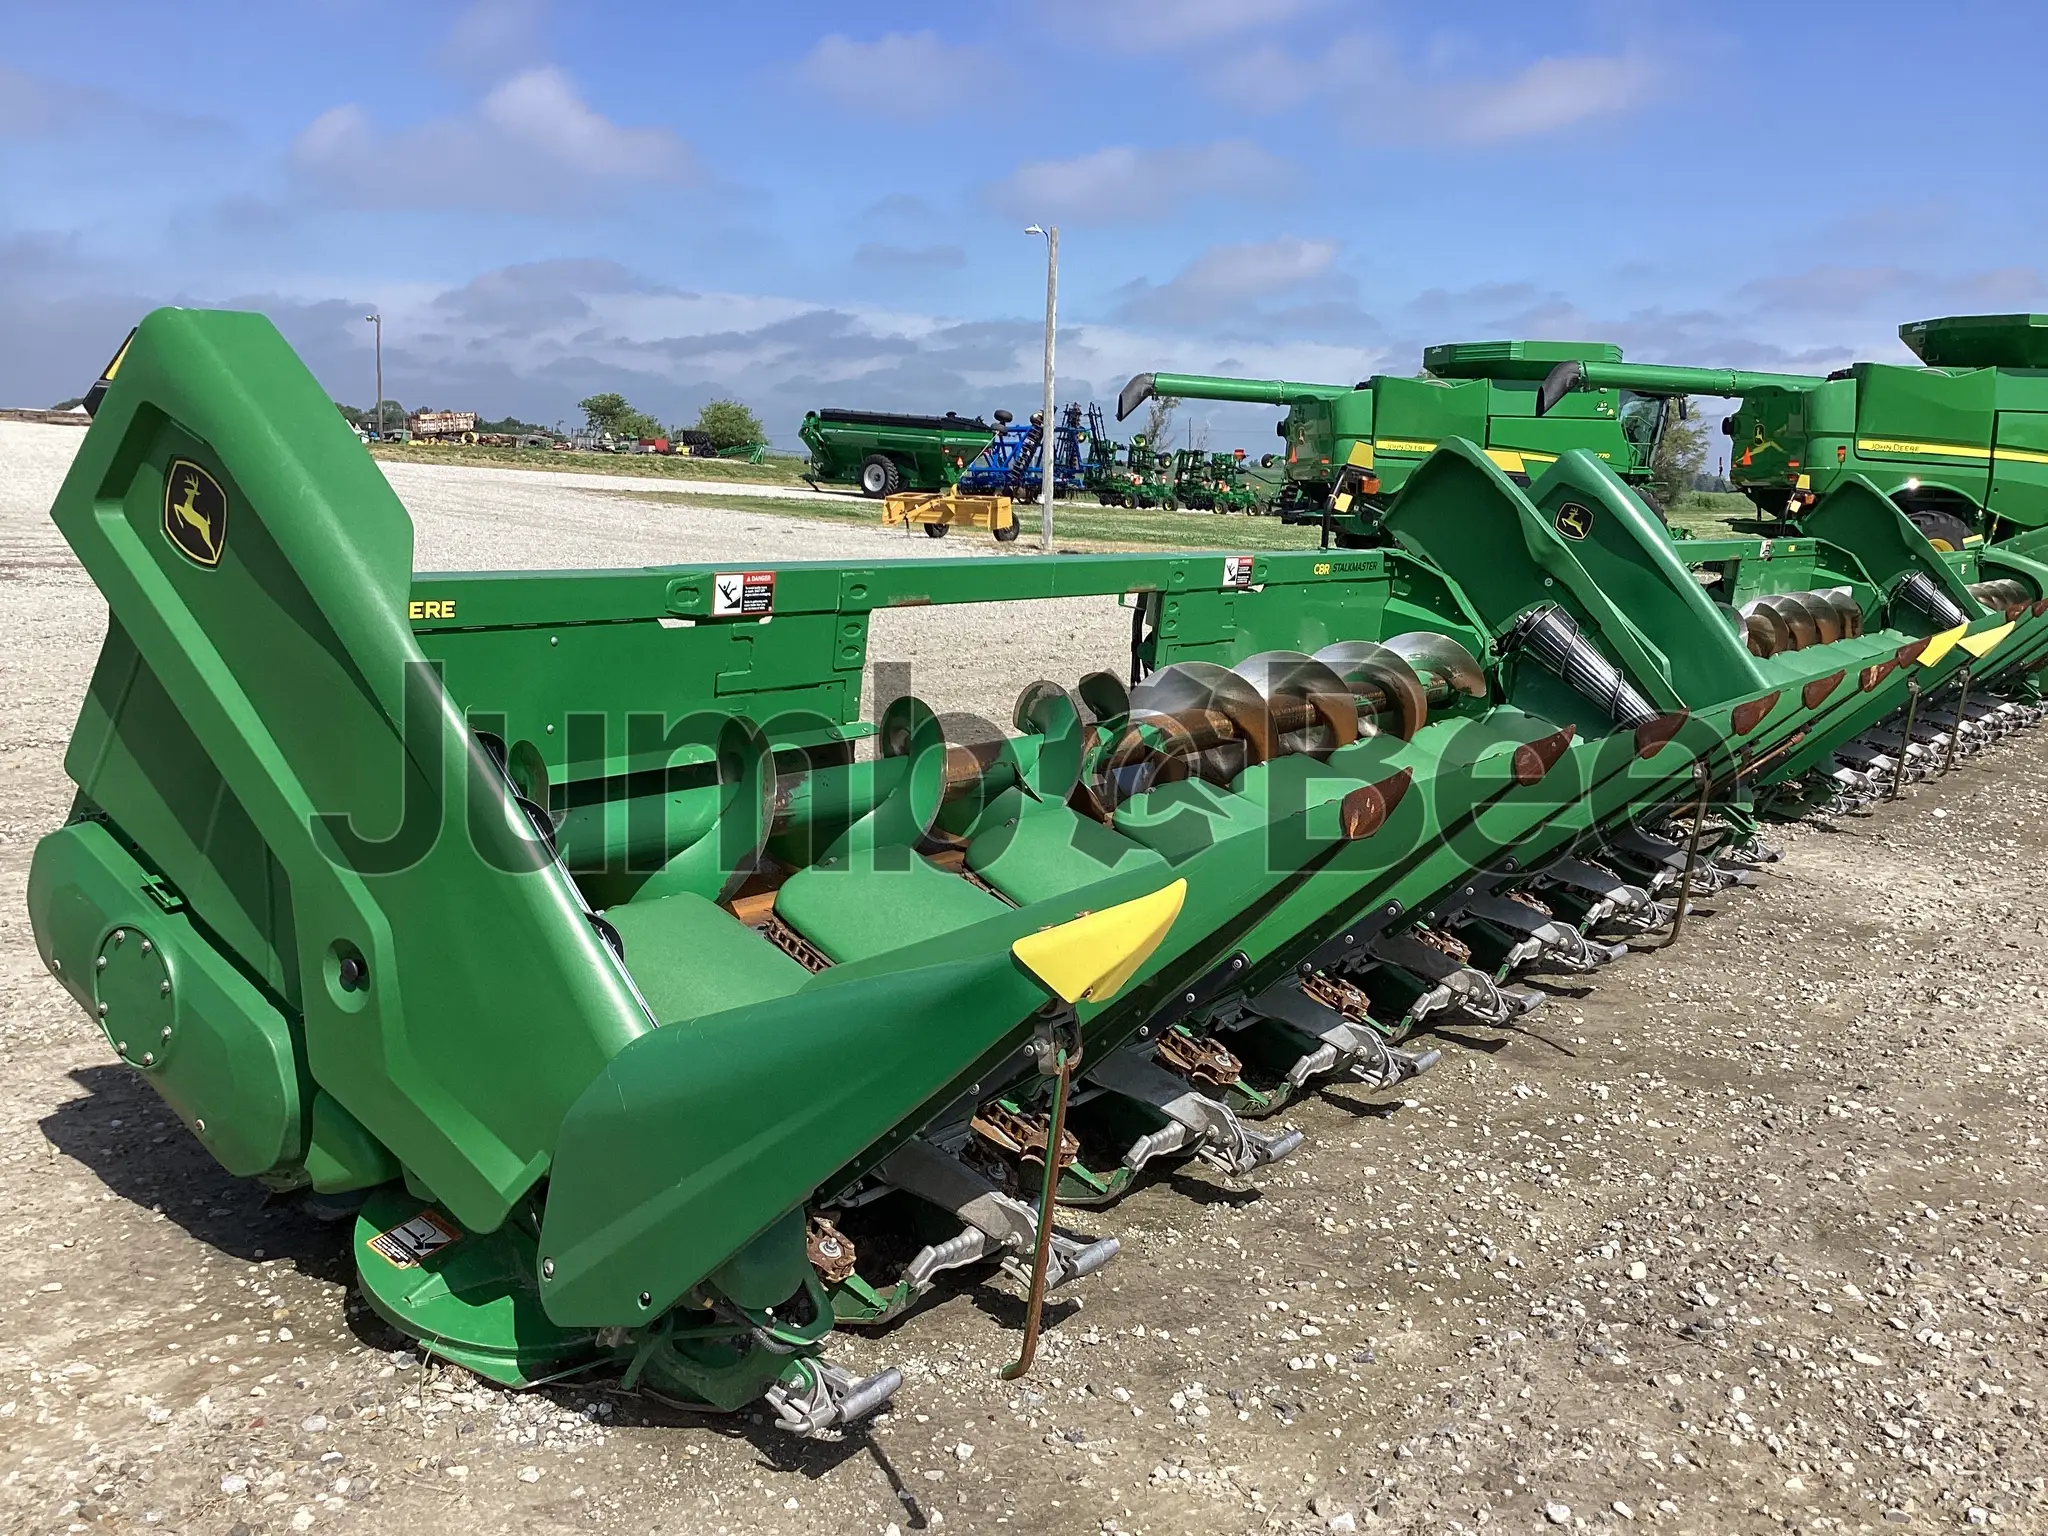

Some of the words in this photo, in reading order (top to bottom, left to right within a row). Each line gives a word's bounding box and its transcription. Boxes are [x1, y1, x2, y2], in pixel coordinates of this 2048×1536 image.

[1870, 443, 1892, 451] JOHN
[1332, 561, 1378, 573] STALKMASTER
[751, 574, 772, 582] DANGER
